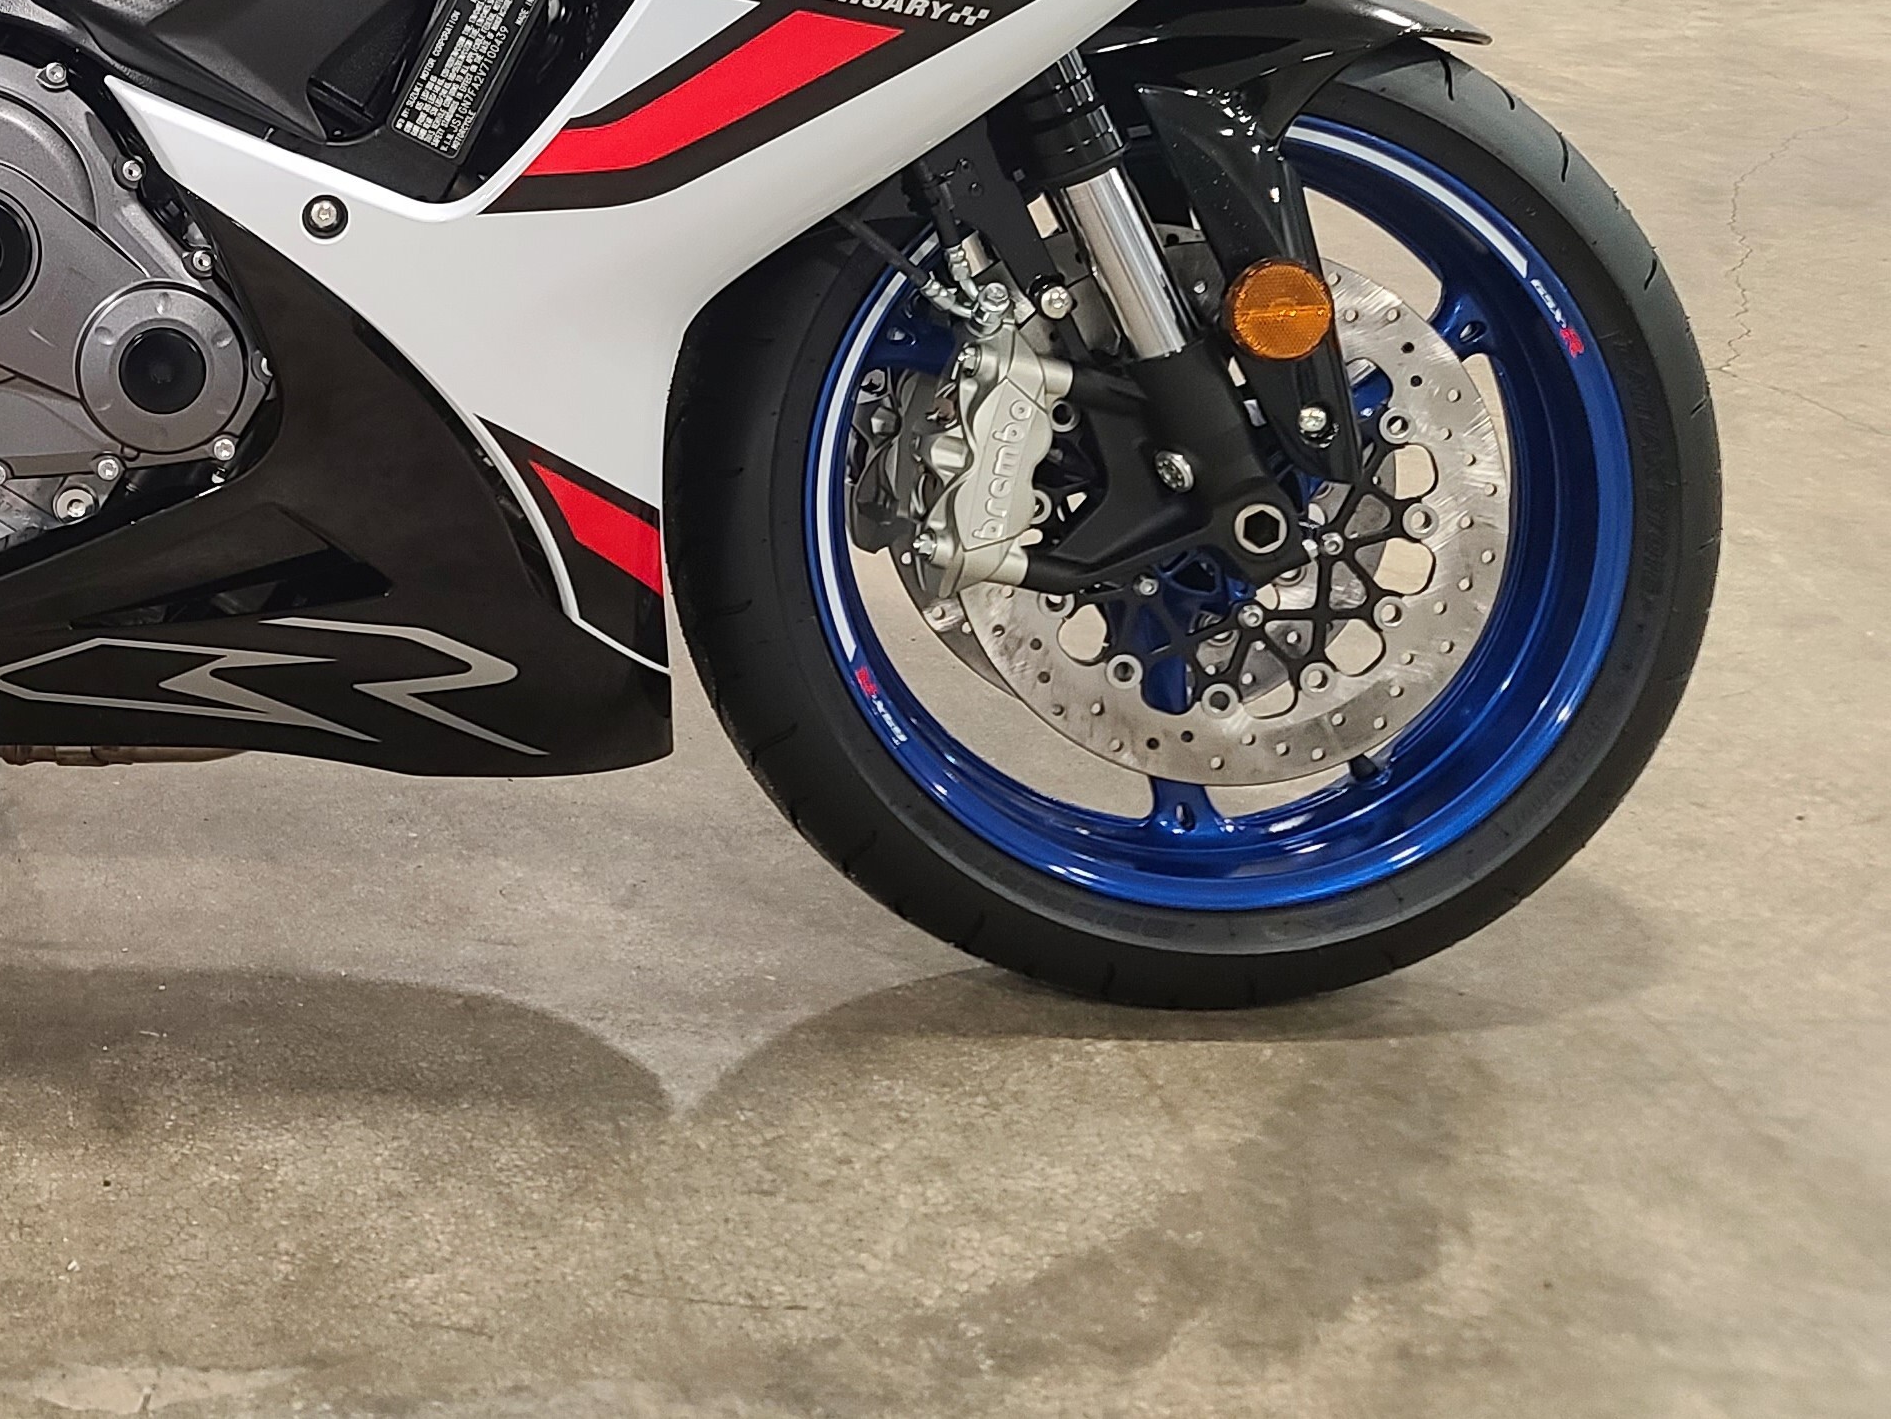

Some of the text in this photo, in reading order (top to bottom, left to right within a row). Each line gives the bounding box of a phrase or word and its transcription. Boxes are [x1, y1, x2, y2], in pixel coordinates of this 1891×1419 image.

[514, 7, 529, 26] MADE
[406, 82, 424, 107] SUZUKI
[421, 57, 437, 81] MOTOR
[433, 10, 461, 56] CORPORATION
[450, 109, 477, 150] MOTORCYCLE
[971, 399, 1032, 538] brembo
